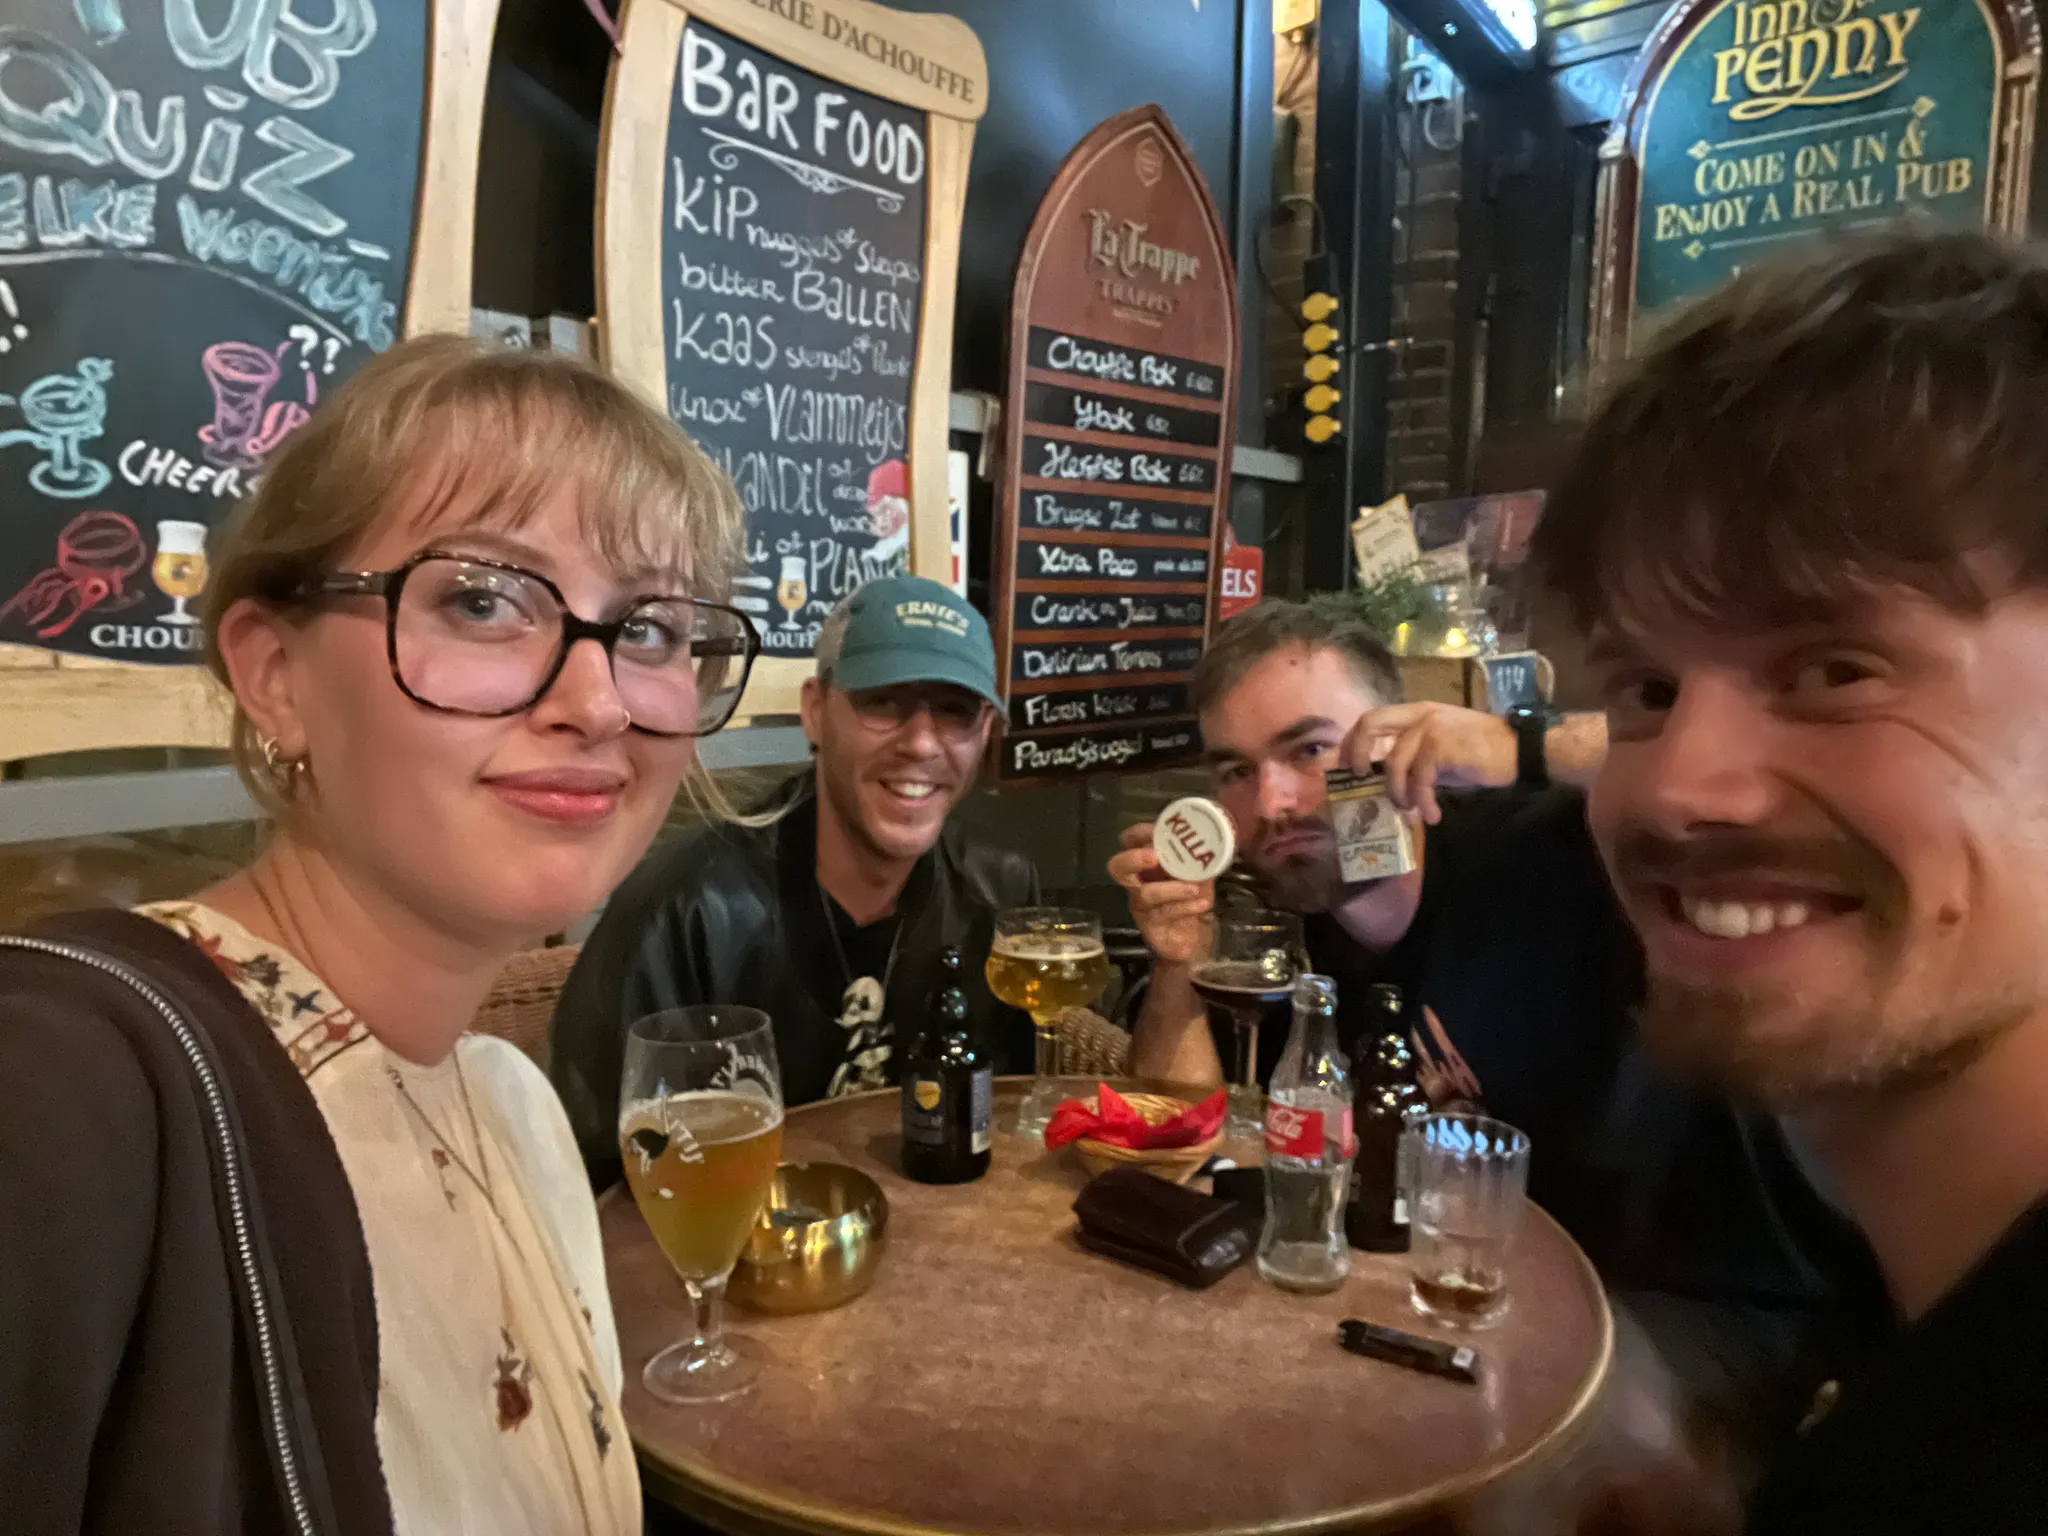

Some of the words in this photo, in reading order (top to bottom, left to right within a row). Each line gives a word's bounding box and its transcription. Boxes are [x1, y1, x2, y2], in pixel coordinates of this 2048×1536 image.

[822, 11, 976, 104] D'ACHOUFFE
[814, 92, 924, 184] FOOD
[1759, 192, 1782, 224] A
[118, 438, 263, 499] CHEER
[90, 623, 206, 650] CHOU
[1165, 812, 1217, 871] KILLA
